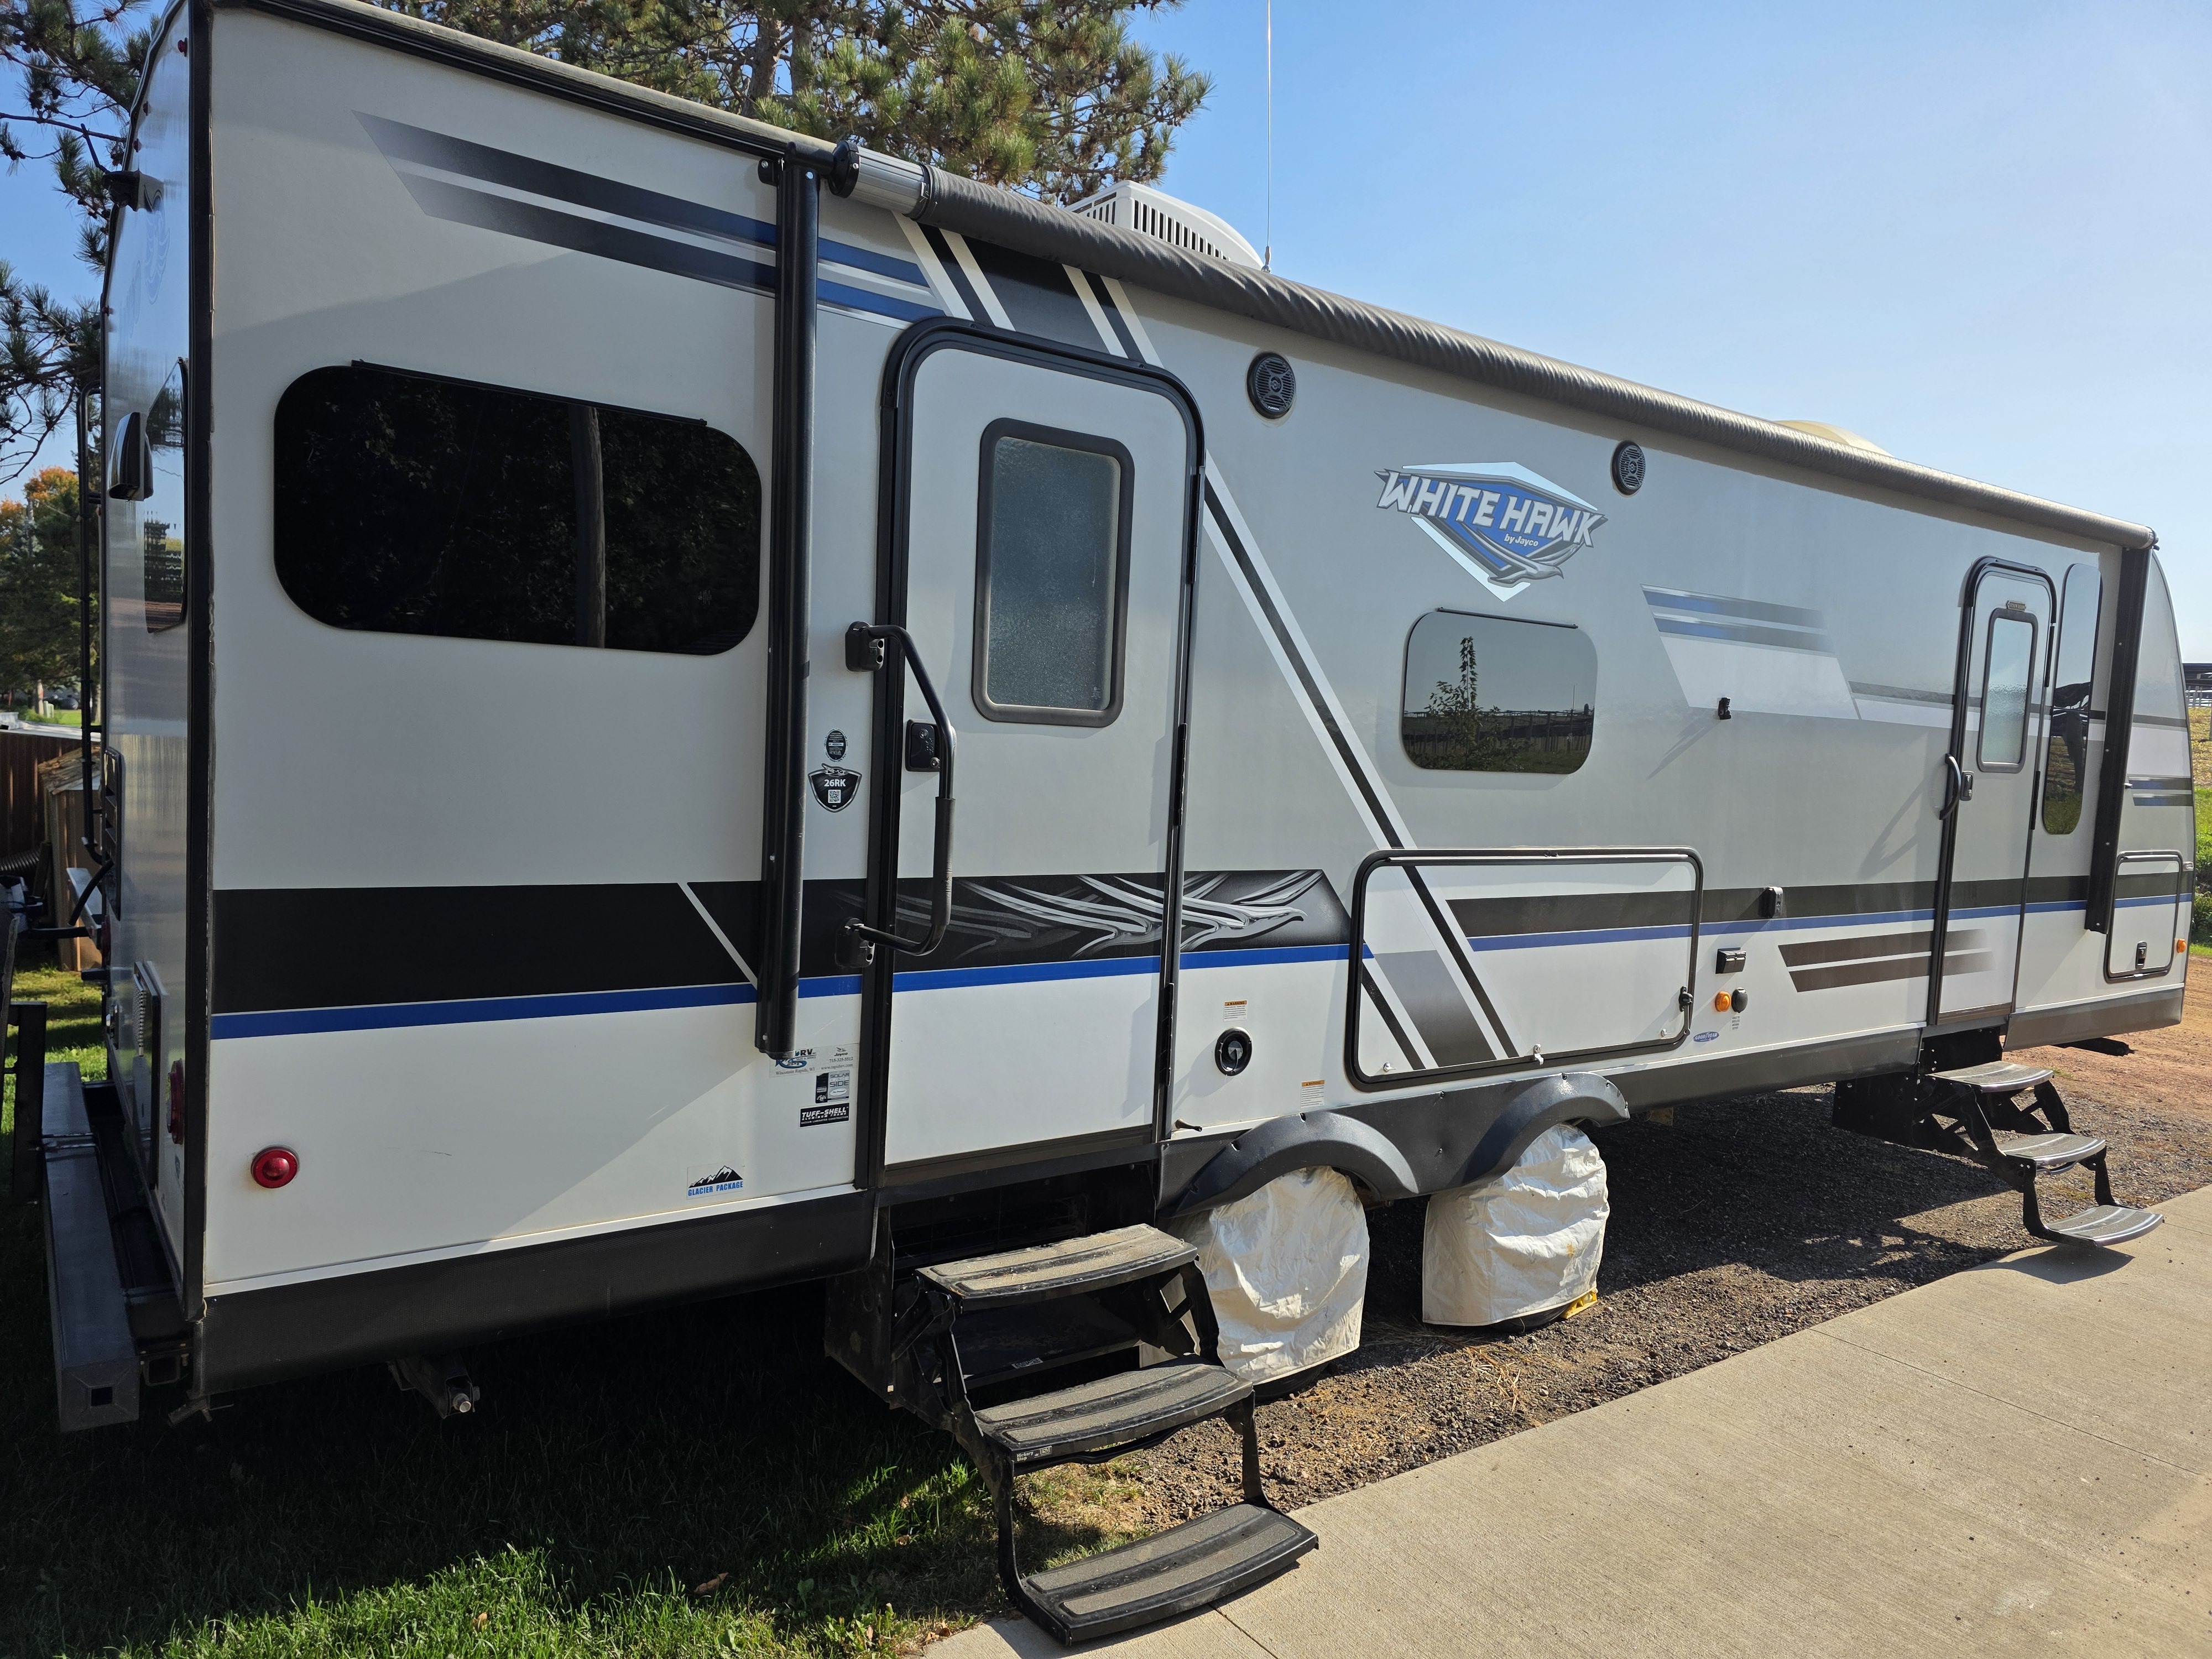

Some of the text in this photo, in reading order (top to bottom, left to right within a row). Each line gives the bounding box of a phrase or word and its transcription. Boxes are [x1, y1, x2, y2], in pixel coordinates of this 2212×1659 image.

[1377, 469, 1605, 548] WHITE HAWK
[1504, 533, 1539, 547] by Jayco
[824, 779, 846, 787] 26RK
[1694, 1032, 1718, 1040] GOODYEAR
[802, 1107, 847, 1118] TUFF-SHELL
[688, 1181, 743, 1196] GLACIER PACKAGE
